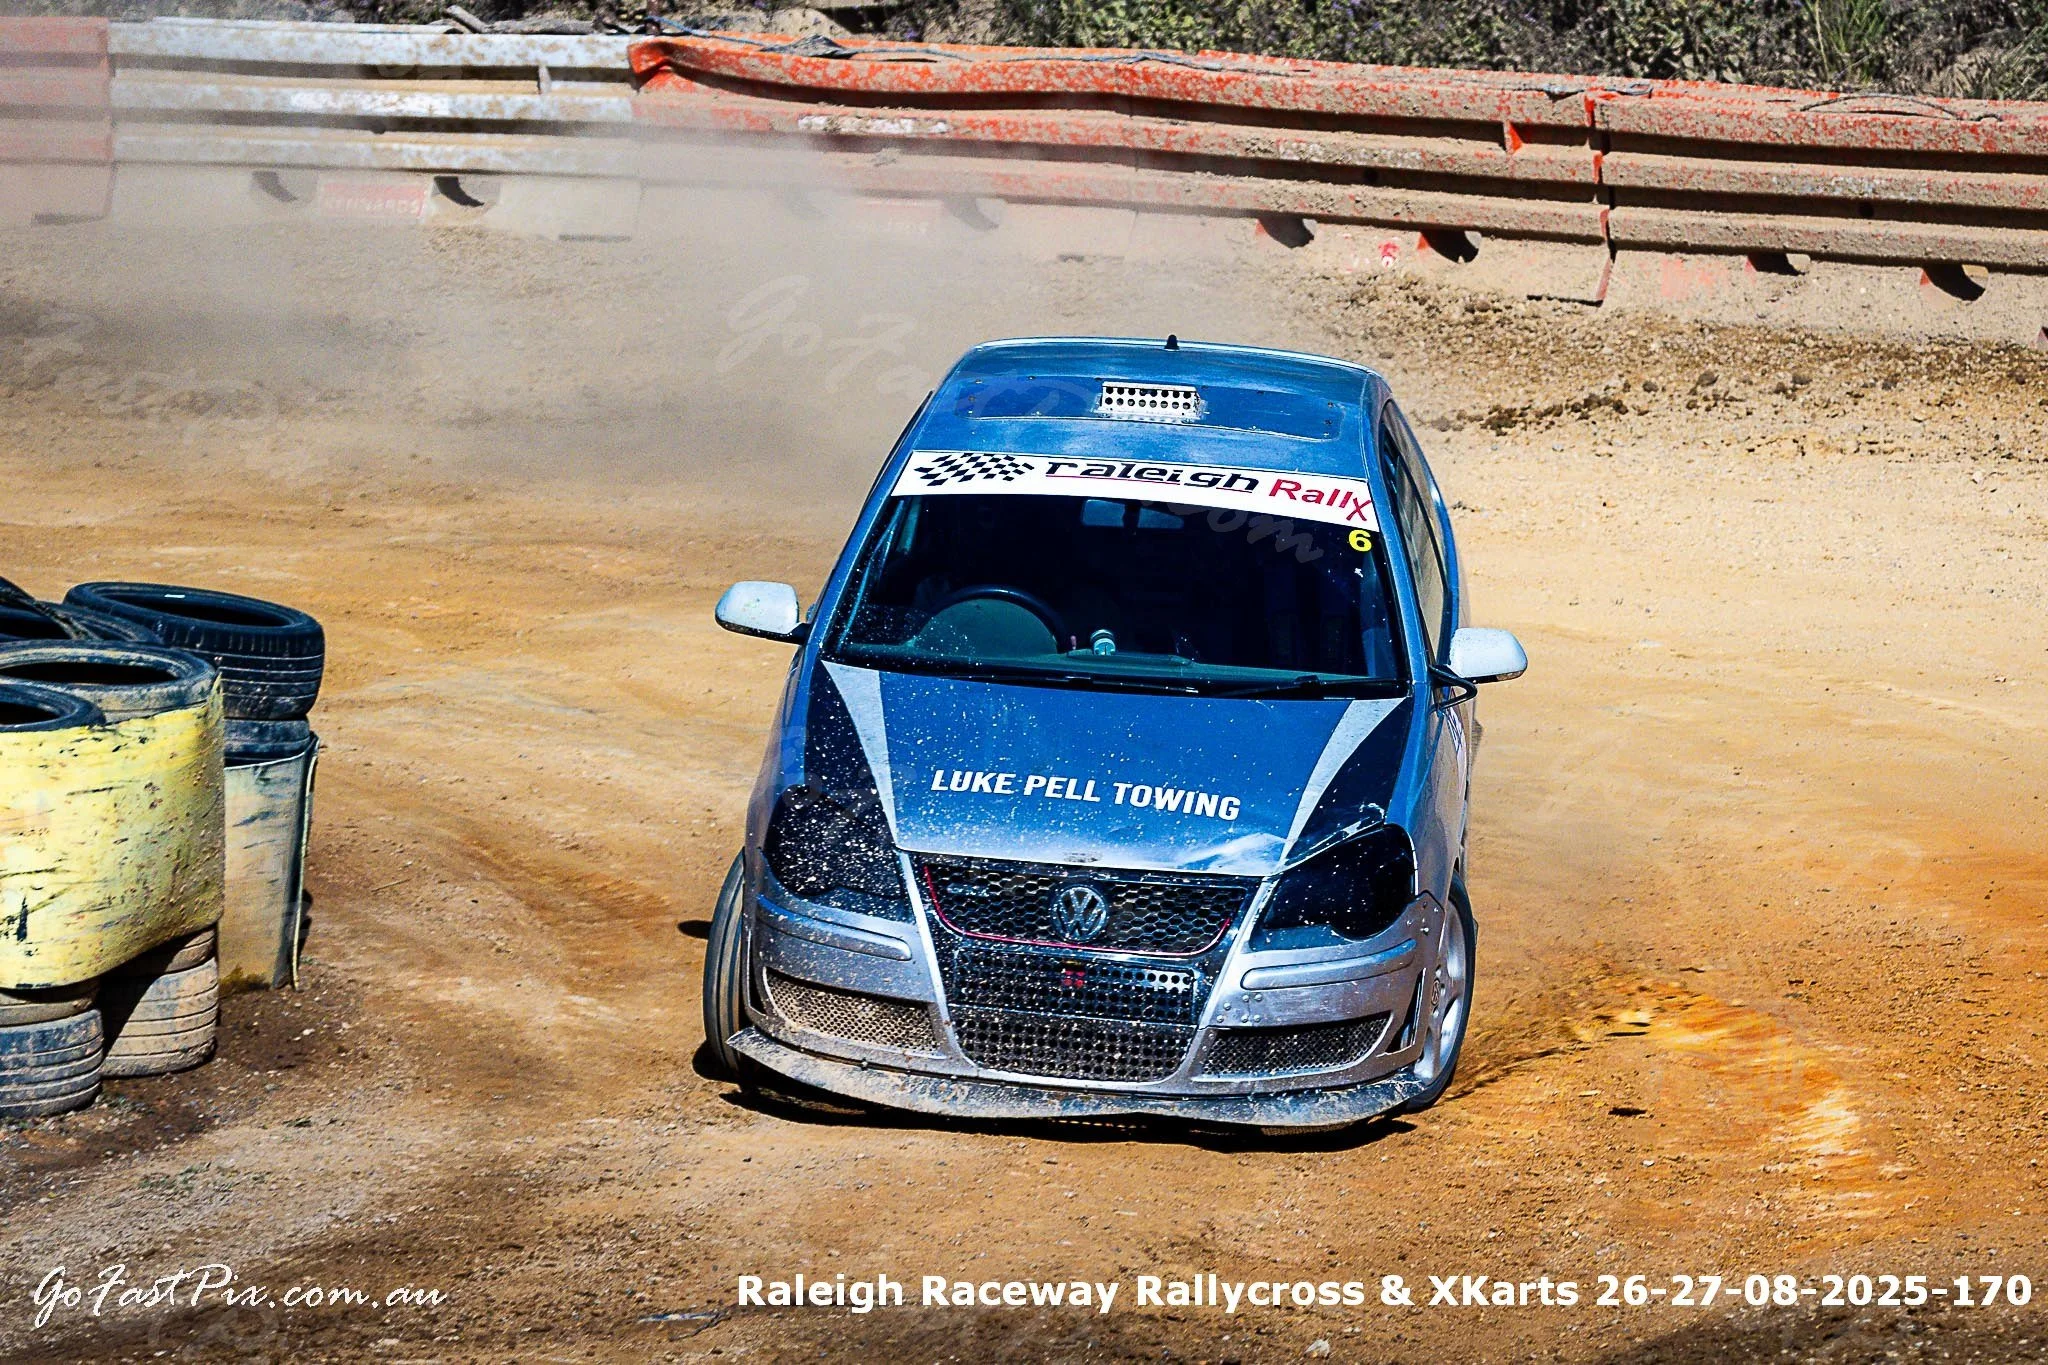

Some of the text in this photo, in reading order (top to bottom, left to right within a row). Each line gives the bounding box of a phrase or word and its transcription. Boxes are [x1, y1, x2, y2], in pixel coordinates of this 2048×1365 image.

[1045, 461, 1260, 493] raleigh
[1349, 529, 1372, 552] 6
[931, 769, 1241, 821] LUKE PELL TOWING
[1052, 884, 1109, 943] VW
